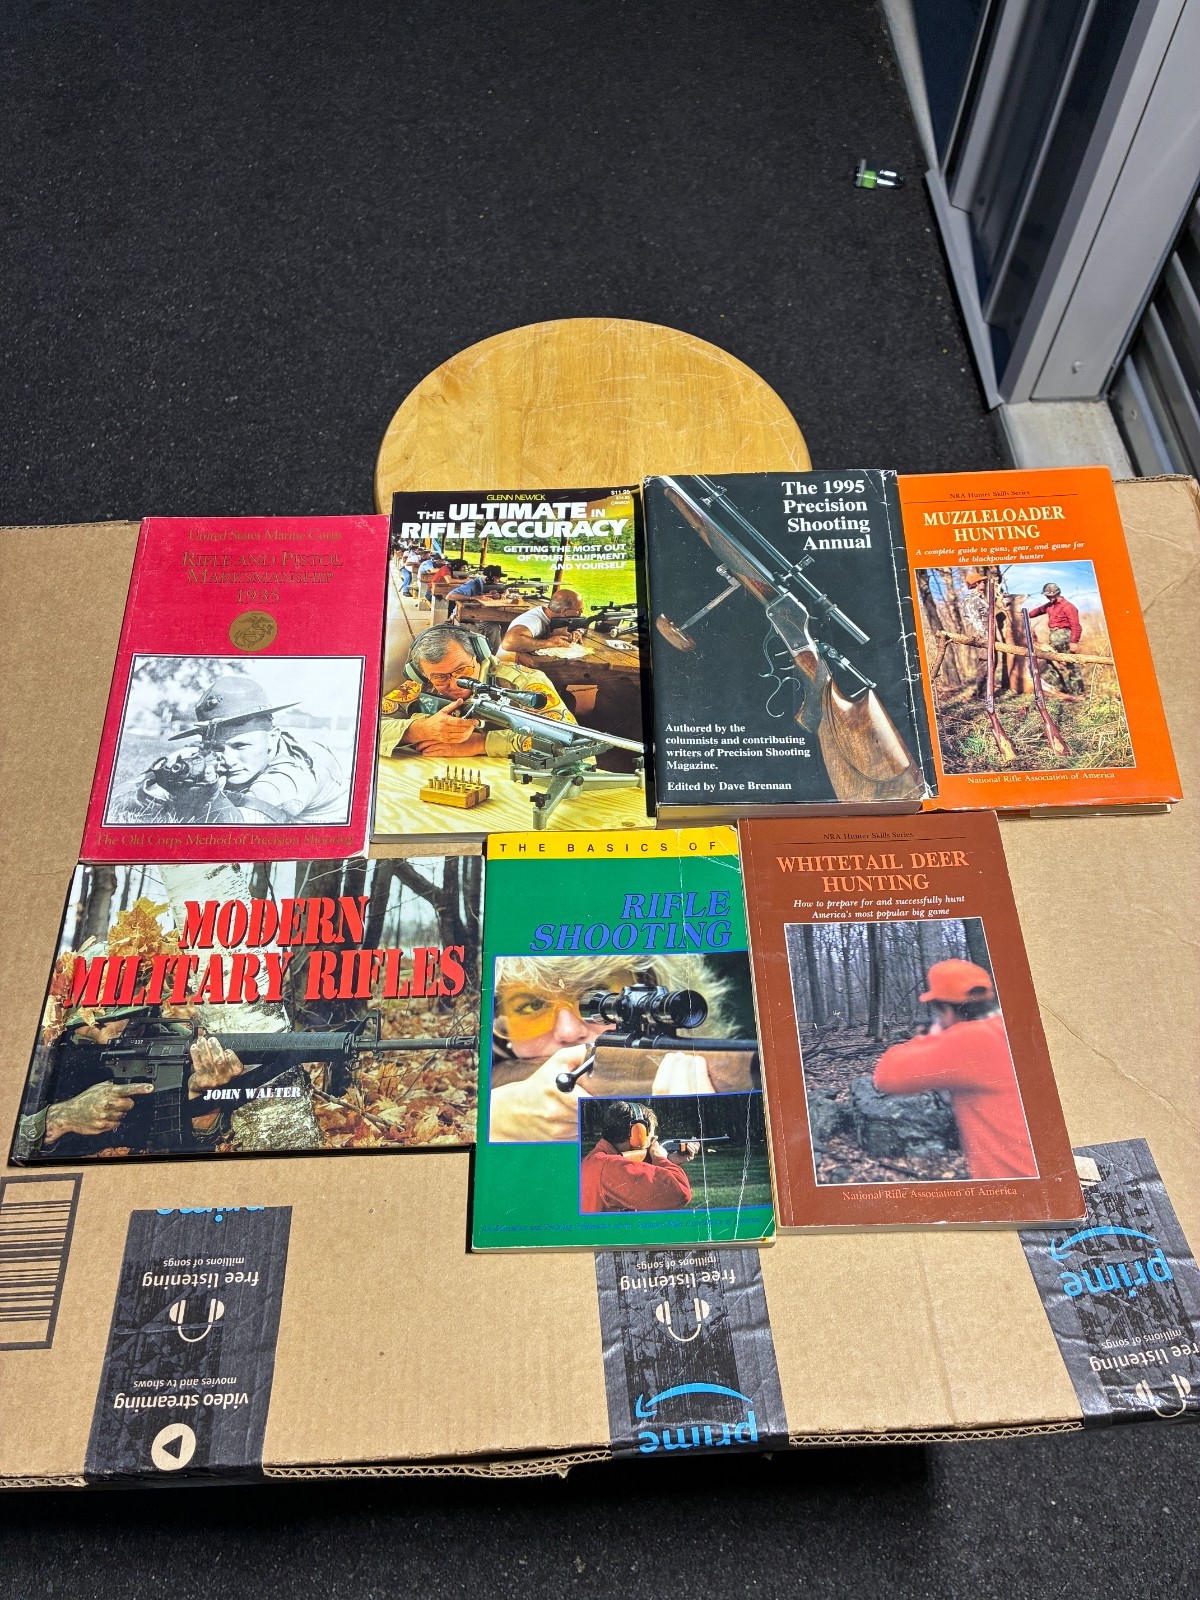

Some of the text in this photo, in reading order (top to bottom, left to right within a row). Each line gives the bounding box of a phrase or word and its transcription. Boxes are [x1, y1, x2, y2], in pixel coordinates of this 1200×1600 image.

[782, 479, 865, 495] The 1995
[968, 491, 991, 499] Hunter
[992, 490, 1010, 498] Skills
[515, 493, 546, 501] NEWICK
[417, 502, 605, 520] THE ULTIMATE IN
[782, 498, 868, 514] Precision
[923, 505, 1066, 526] MUZZLELOADER
[401, 519, 629, 539] RIFLE ACCURACY
[787, 516, 871, 533] Shooting
[188, 529, 343, 542] United States Marine Corps
[953, 524, 1041, 543] HUNTING
[503, 543, 627, 553] GETTING THE MOST OUT
[803, 534, 872, 551] Annual
[924, 547, 955, 557] complete
[957, 546, 979, 556] guide
[980, 545, 988, 553] to
[990, 545, 1010, 555] guns,
[1013, 544, 1032, 554] gear,
[1034, 543, 1049, 551] and
[1051, 543, 1071, 552] game
[1073, 541, 1085, 550] for
[182, 551, 344, 567] RIFLE AND PISTOL
[517, 552, 627, 562] OF YOUR EQUIPMENT
[972, 554, 1018, 564] blackpowder
[1019, 553, 1045, 561] hunter
[550, 561, 628, 571] AND YOURSELF
[187, 568, 335, 584] MARKSMANSHIP
[236, 588, 281, 605] 1935
[665, 723, 746, 735] Authored by the
[665, 735, 806, 746] columnists and contributing
[666, 747, 811, 758] writers of Precision Shooting
[666, 760, 719, 771] Magazine.
[967, 771, 1116, 784] National Rifle Association of America
[667, 780, 793, 793] Edited by Dave Brennan
[95, 833, 119, 846] The
[121, 833, 144, 846] Old
[147, 833, 183, 847] Corps
[185, 833, 231, 846] Method
[233, 833, 247, 845] of
[250, 833, 300, 845] Precision
[500, 841, 717, 852] THE BASICS OF
[776, 850, 970, 873] WHITETAIL DEER
[822, 873, 930, 893] HUNTING
[619, 890, 732, 920] RIFLE
[793, 900, 814, 908] How
[816, 899, 824, 907] to
[826, 899, 858, 909] prepare
[860, 897, 874, 908] for
[876, 897, 893, 906] and
[945, 895, 966, 903] hunt
[812, 908, 950, 919] America's most popular big game
[177, 896, 370, 949] MODERN
[530, 920, 733, 952] SHOOTING
[63, 944, 467, 1008] MILITARY RIFLES
[203, 1085, 302, 1102] JOHN WALTER
[842, 1186, 1018, 1200] National Rifle Association of America
[163, 1257, 245, 1268] millions of songs
[636, 1256, 717, 1270] millions of songs
[142, 1271, 260, 1289] free listening
[620, 1269, 737, 1293] free listening
[1060, 1248, 1174, 1298] prime
[1101, 1329, 1182, 1349] millions of songs
[1089, 1342, 1200, 1373] ree listening
[133, 1376, 237, 1388] movies and tv shows
[114, 1393, 249, 1412] video streaming
[638, 1411, 759, 1453] prime
